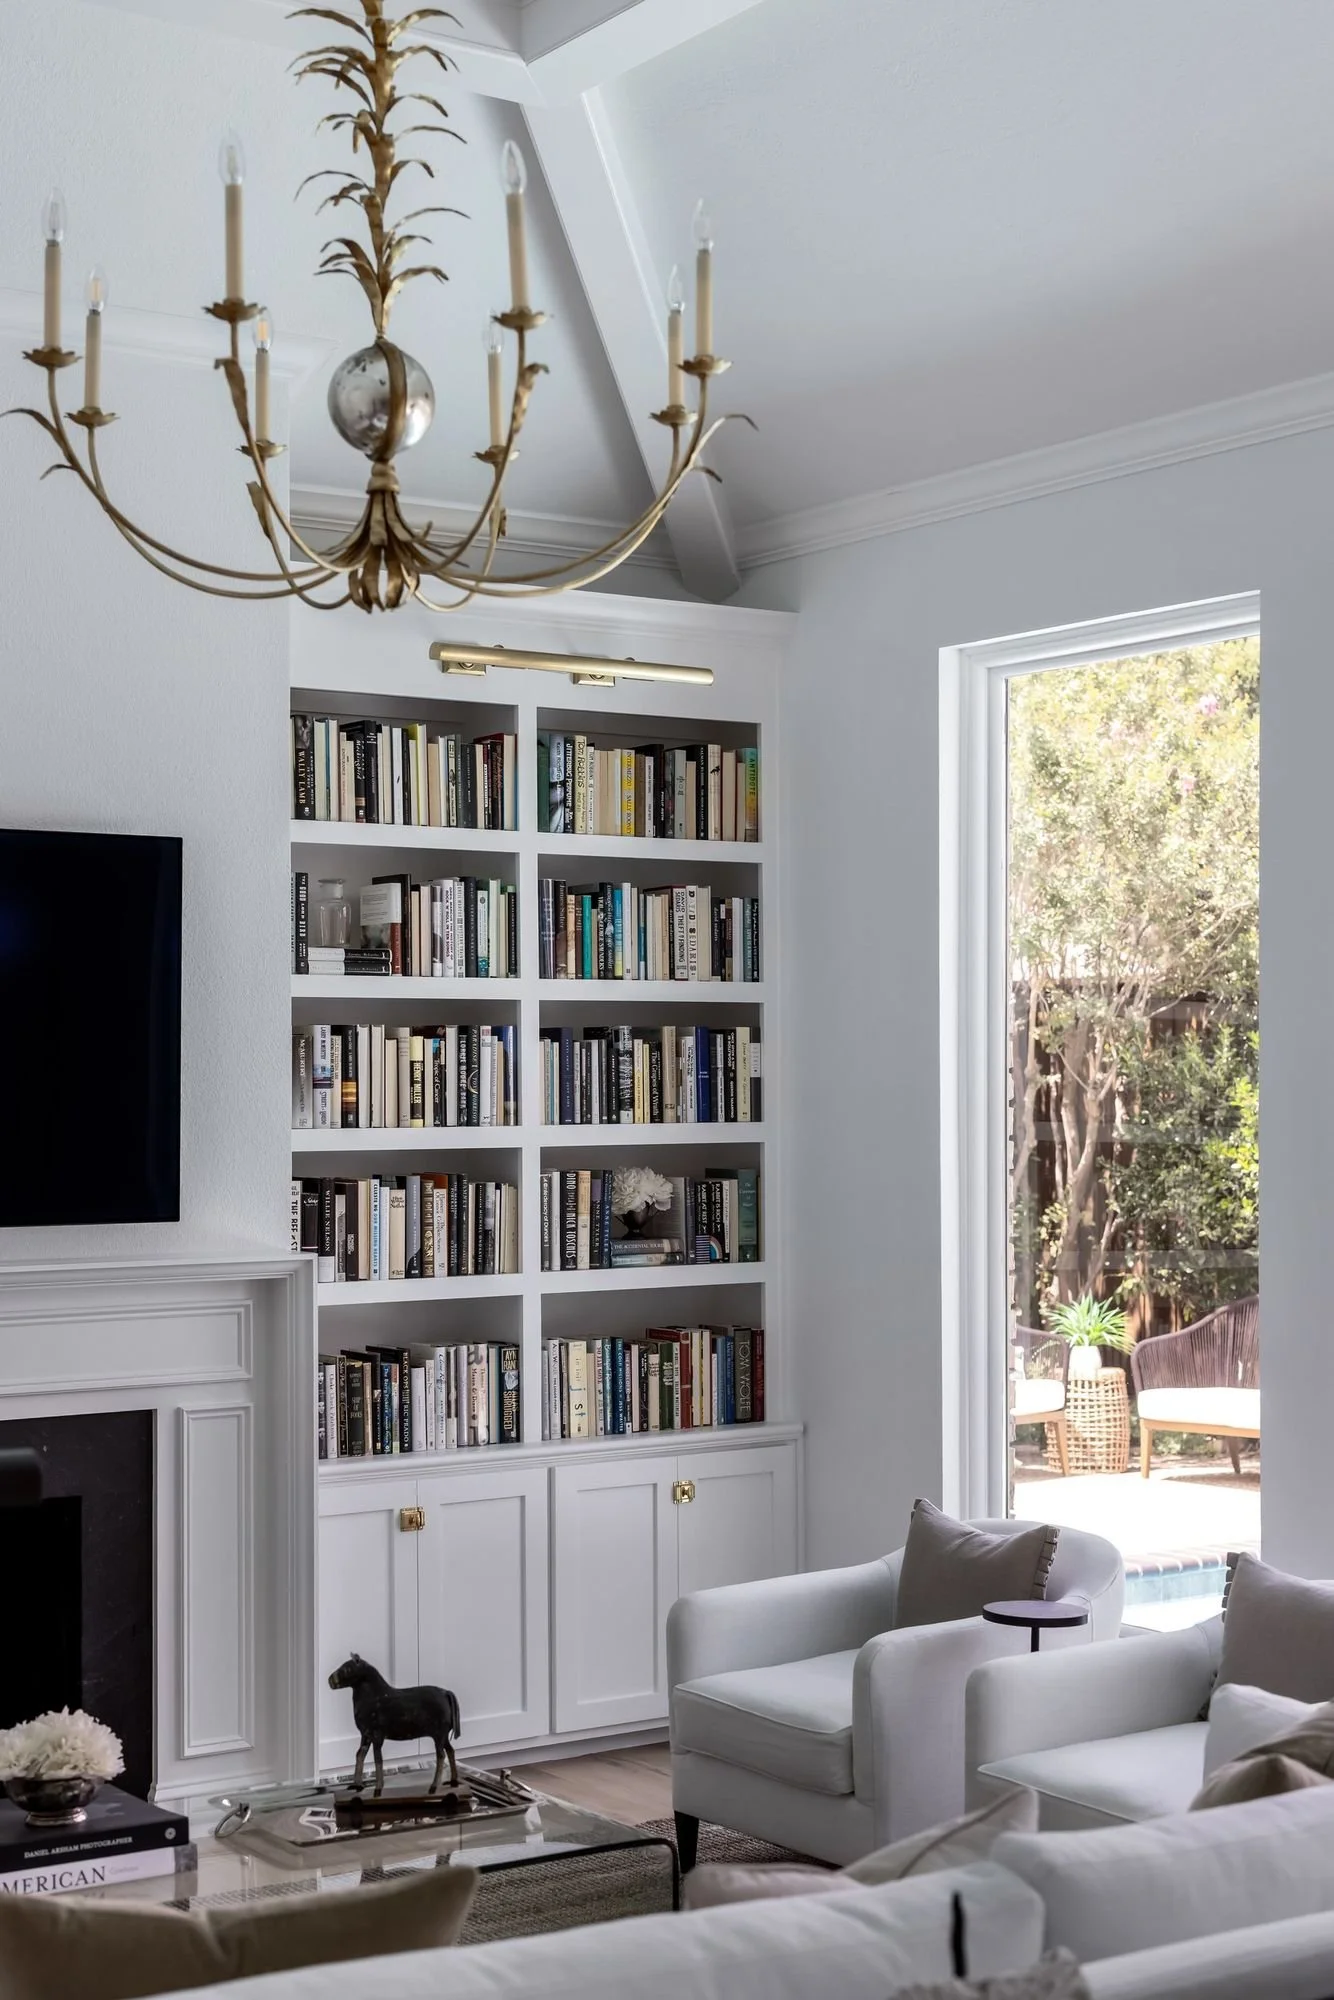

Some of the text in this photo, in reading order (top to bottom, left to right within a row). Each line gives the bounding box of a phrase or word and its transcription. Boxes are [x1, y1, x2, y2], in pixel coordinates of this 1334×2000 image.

[414, 1062, 422, 1104] HENRY MILLER
[650, 1064, 658, 1086] Grapes
[566, 1174, 577, 1190] DINO
[542, 1183, 550, 1215] Confederacy
[566, 1212, 577, 1229] MICK
[566, 1231, 577, 1259] TOSCHES
[506, 1350, 517, 1361] AYN
[738, 1340, 751, 1412] TOM WOLFE
[504, 1391, 513, 1430] SHRUGGED
[24, 1836, 133, 1859] DANIEL ARSHAM PHOTOGRAPHER
[1, 1865, 106, 1896] MERICAN
